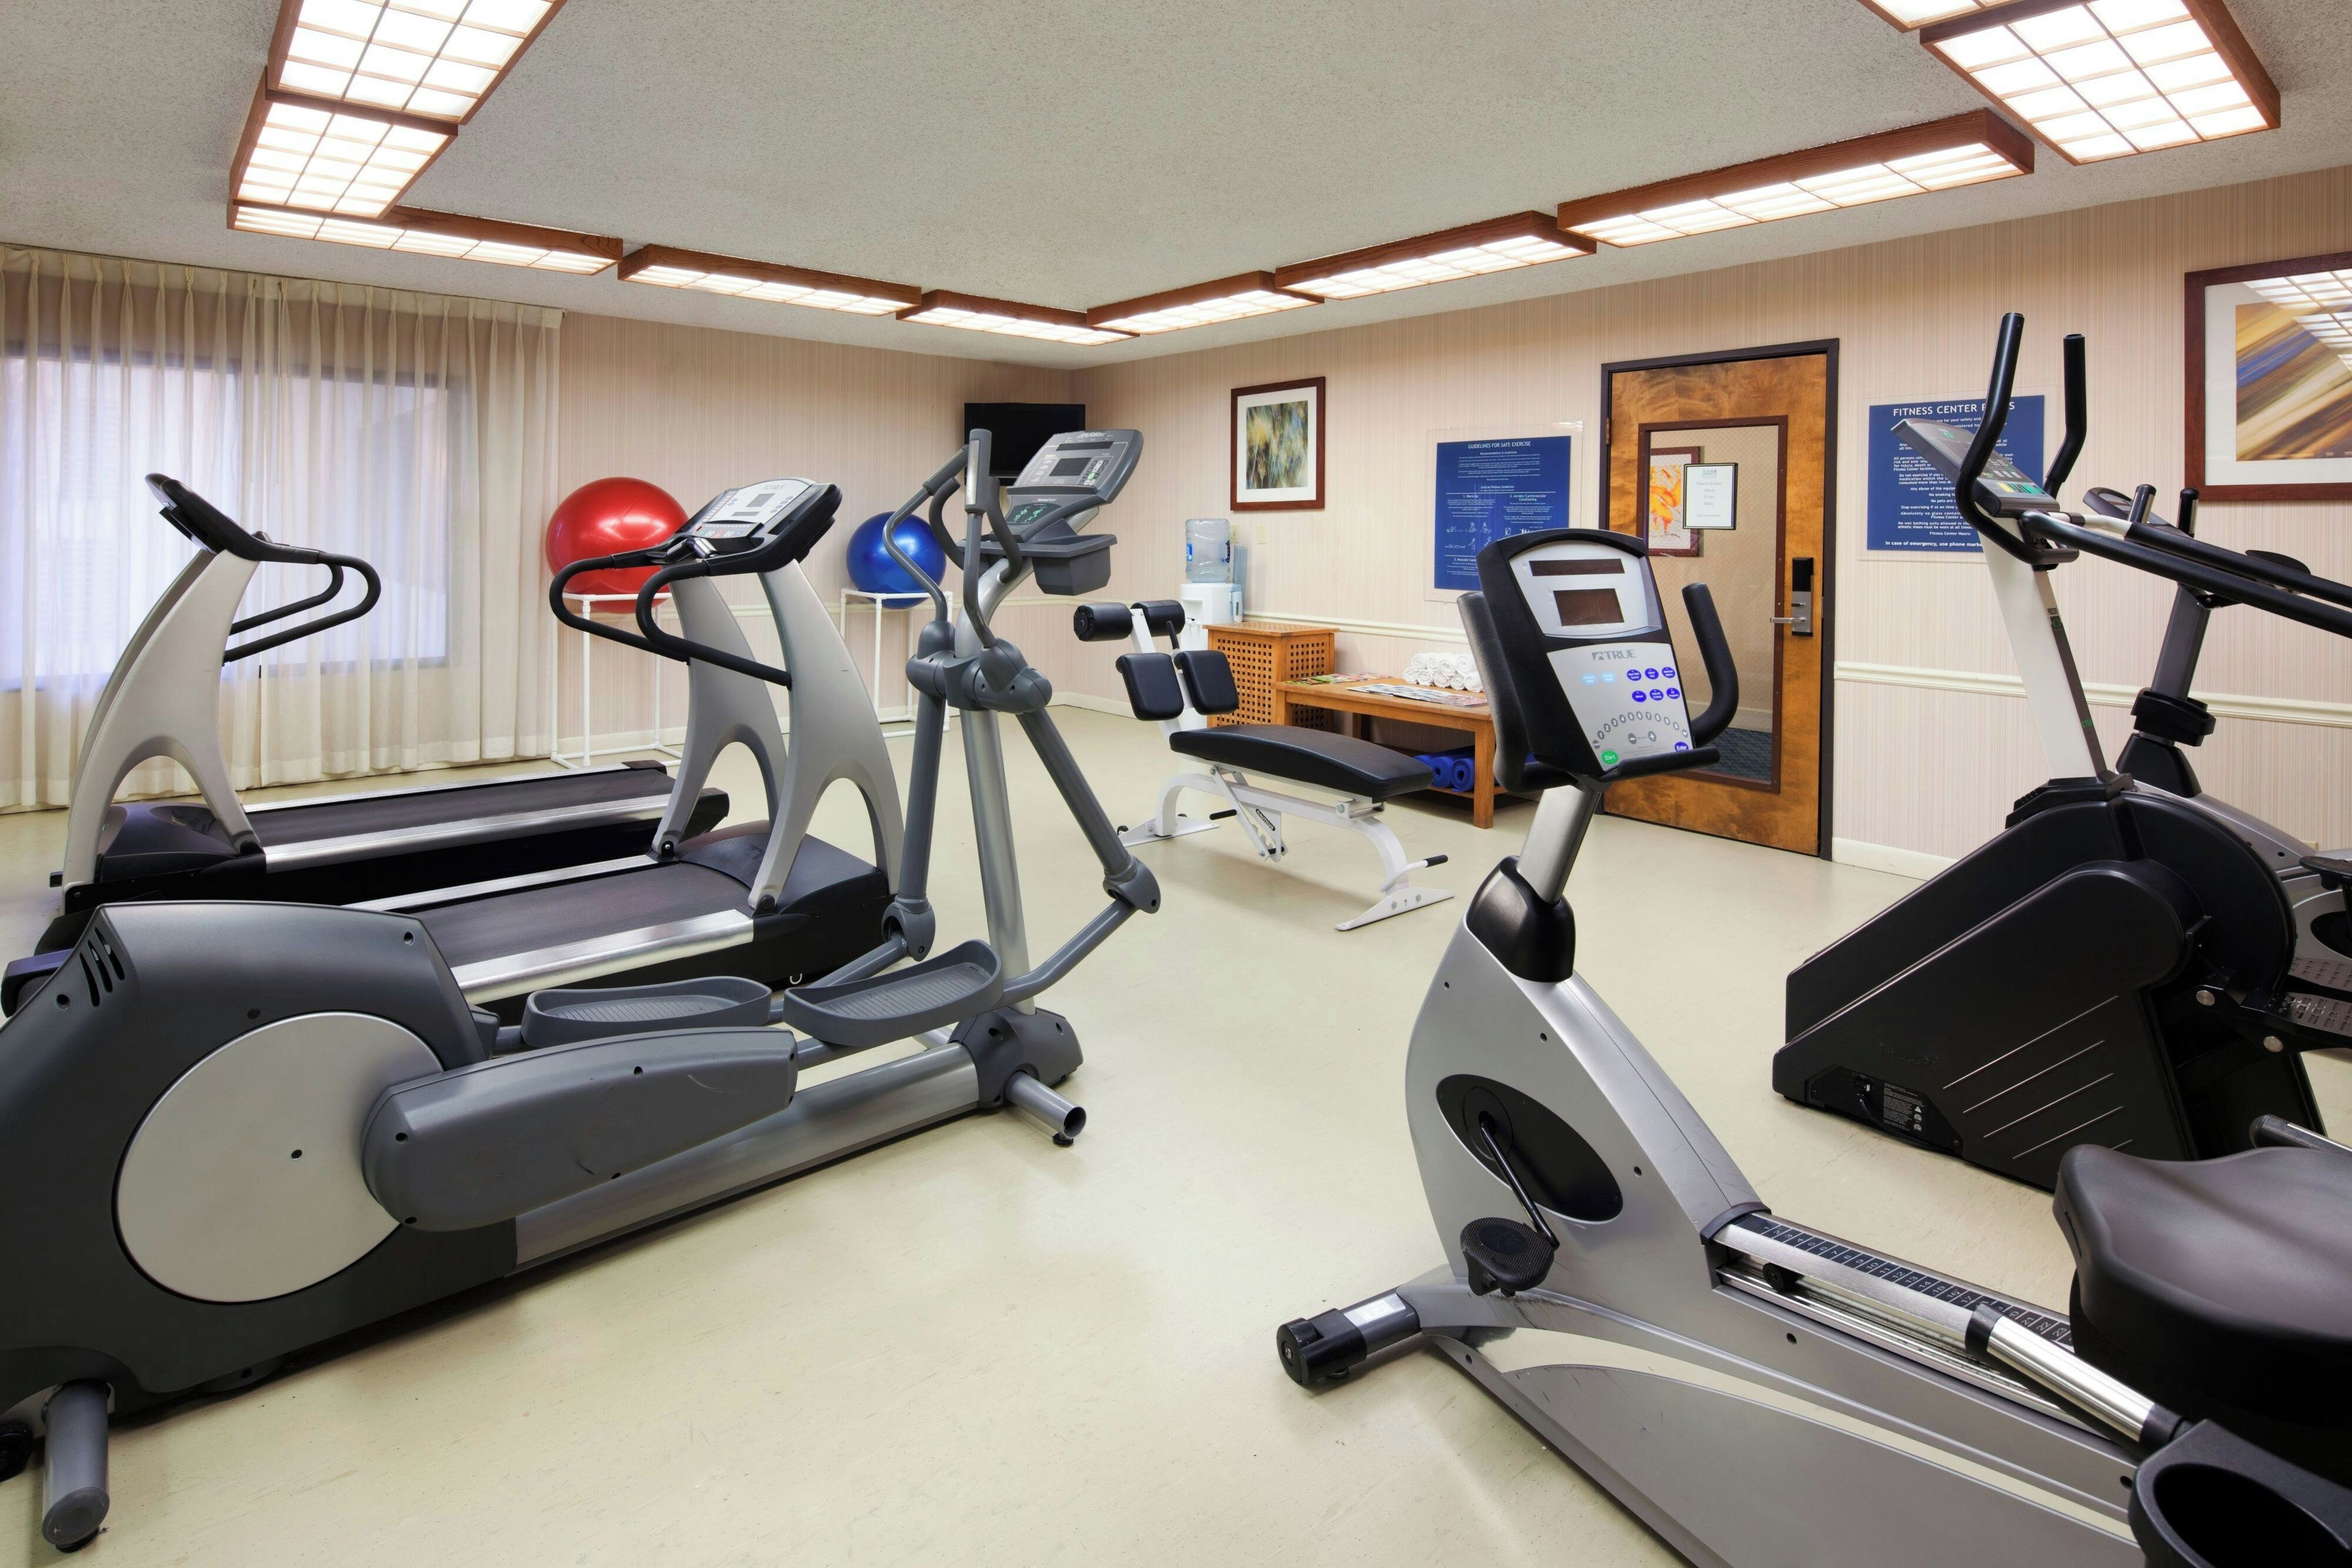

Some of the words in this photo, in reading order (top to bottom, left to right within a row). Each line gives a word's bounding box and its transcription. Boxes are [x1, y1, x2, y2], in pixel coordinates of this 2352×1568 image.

[1893, 407, 1933, 417] FITNESS
[1937, 404, 1977, 414] CENTER
[1604, 649, 1637, 660] TRUE
[1893, 1272, 1905, 1280] 12
[1919, 1281, 1931, 1289] 14
[1947, 1289, 1960, 1298] 16
[2022, 1316, 2035, 1325] 21
[2036, 1322, 2051, 1332] 22
[2052, 1327, 2067, 1336] 23
